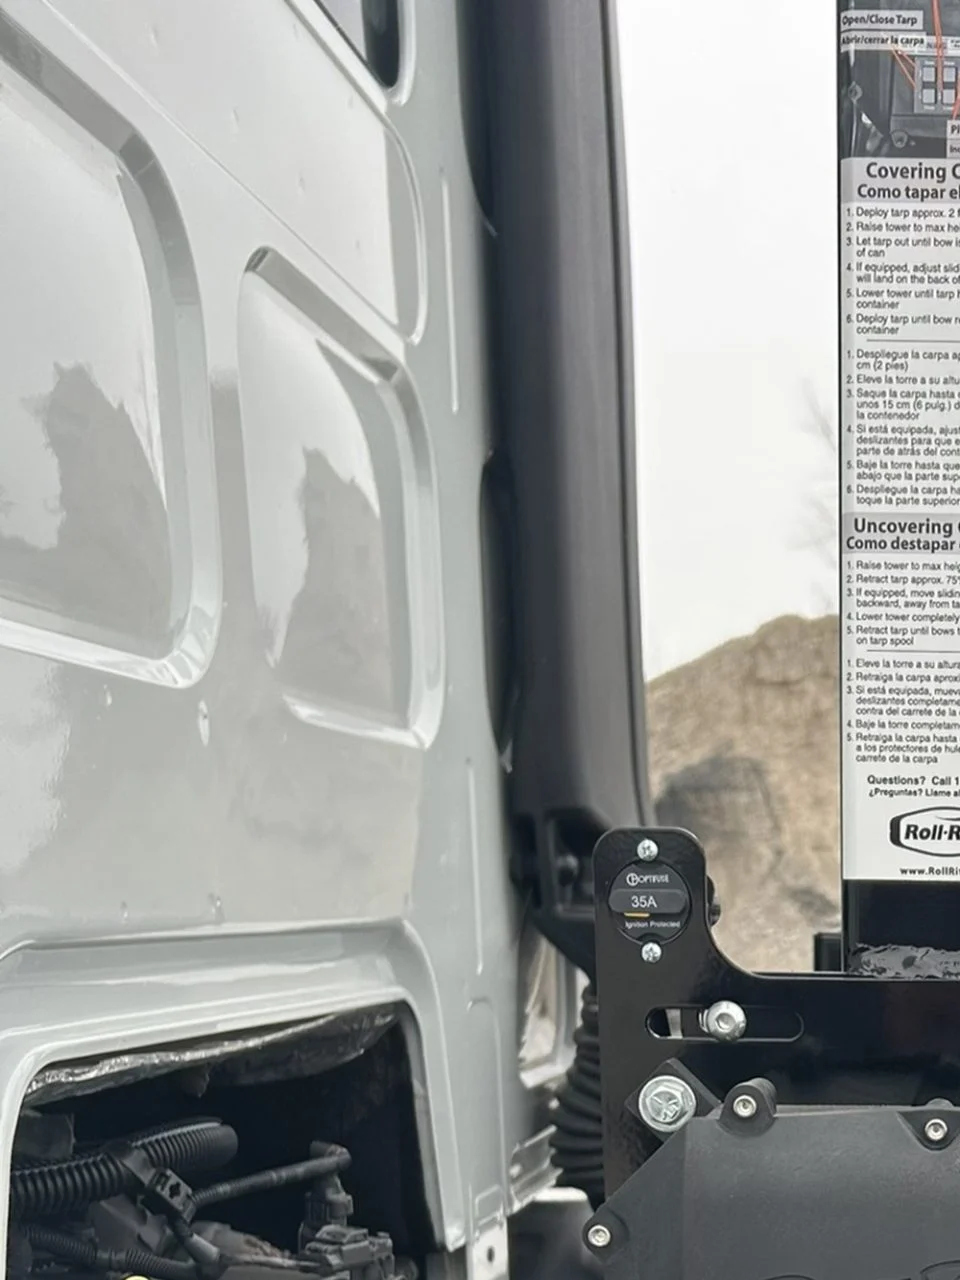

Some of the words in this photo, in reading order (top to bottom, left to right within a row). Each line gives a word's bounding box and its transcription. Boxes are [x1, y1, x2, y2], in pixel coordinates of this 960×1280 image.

[842, 14, 895, 26] Open/Close
[896, 16, 918, 26] Tarp
[890, 35, 898, 45] la
[900, 36, 924, 46] carpa
[866, 162, 946, 183] Covering
[857, 183, 900, 198] Como
[904, 184, 945, 201] tapar
[856, 207, 888, 218] Deploy
[890, 208, 909, 218] tarp
[912, 209, 945, 219] approx.
[856, 222, 883, 231] Raise
[885, 222, 911, 232] tower
[913, 222, 922, 232] to
[925, 224, 944, 232] max
[856, 236, 871, 246] Let
[873, 236, 892, 248] tarp
[894, 237, 909, 246] out
[911, 237, 930, 246] until
[933, 237, 952, 247] bow
[856, 247, 865, 257] of
[867, 249, 884, 257] can
[854, 517, 952, 538] Uncovering
[846, 535, 887, 549] Como
[890, 536, 955, 553] destapar
[856, 560, 881, 569] Raise
[883, 561, 908, 570] tower
[911, 561, 919, 570] to
[922, 562, 941, 570] max
[856, 573, 888, 583] Retract
[890, 575, 908, 585] tarp
[910, 576, 943, 586] approx.
[856, 587, 862, 599] If
[863, 587, 907, 599] equipped,
[910, 589, 934, 599] move
[856, 598, 901, 608] backward,
[903, 600, 926, 610] away
[929, 599, 949, 608] from
[856, 611, 882, 620] Lower
[885, 612, 909, 621] tower
[911, 612, 960, 623] completely
[856, 625, 888, 635] Retract
[890, 625, 908, 636] tarp
[910, 626, 928, 635] until
[931, 626, 954, 635] bows
[856, 636, 867, 644] on
[869, 636, 887, 646] tarp
[889, 635, 913, 647] spool
[856, 658, 880, 668] Eleve
[882, 658, 890, 668] la
[892, 659, 913, 668] torre
[924, 661, 934, 669] su
[867, 774, 925, 785] Questions?
[931, 775, 951, 785] Call
[868, 787, 922, 798] ¿Preguntas?
[925, 788, 951, 797] Llame
[953, 789, 960, 797] al
[631, 895, 658, 908] 35A
[624, 921, 648, 930] Ignition
